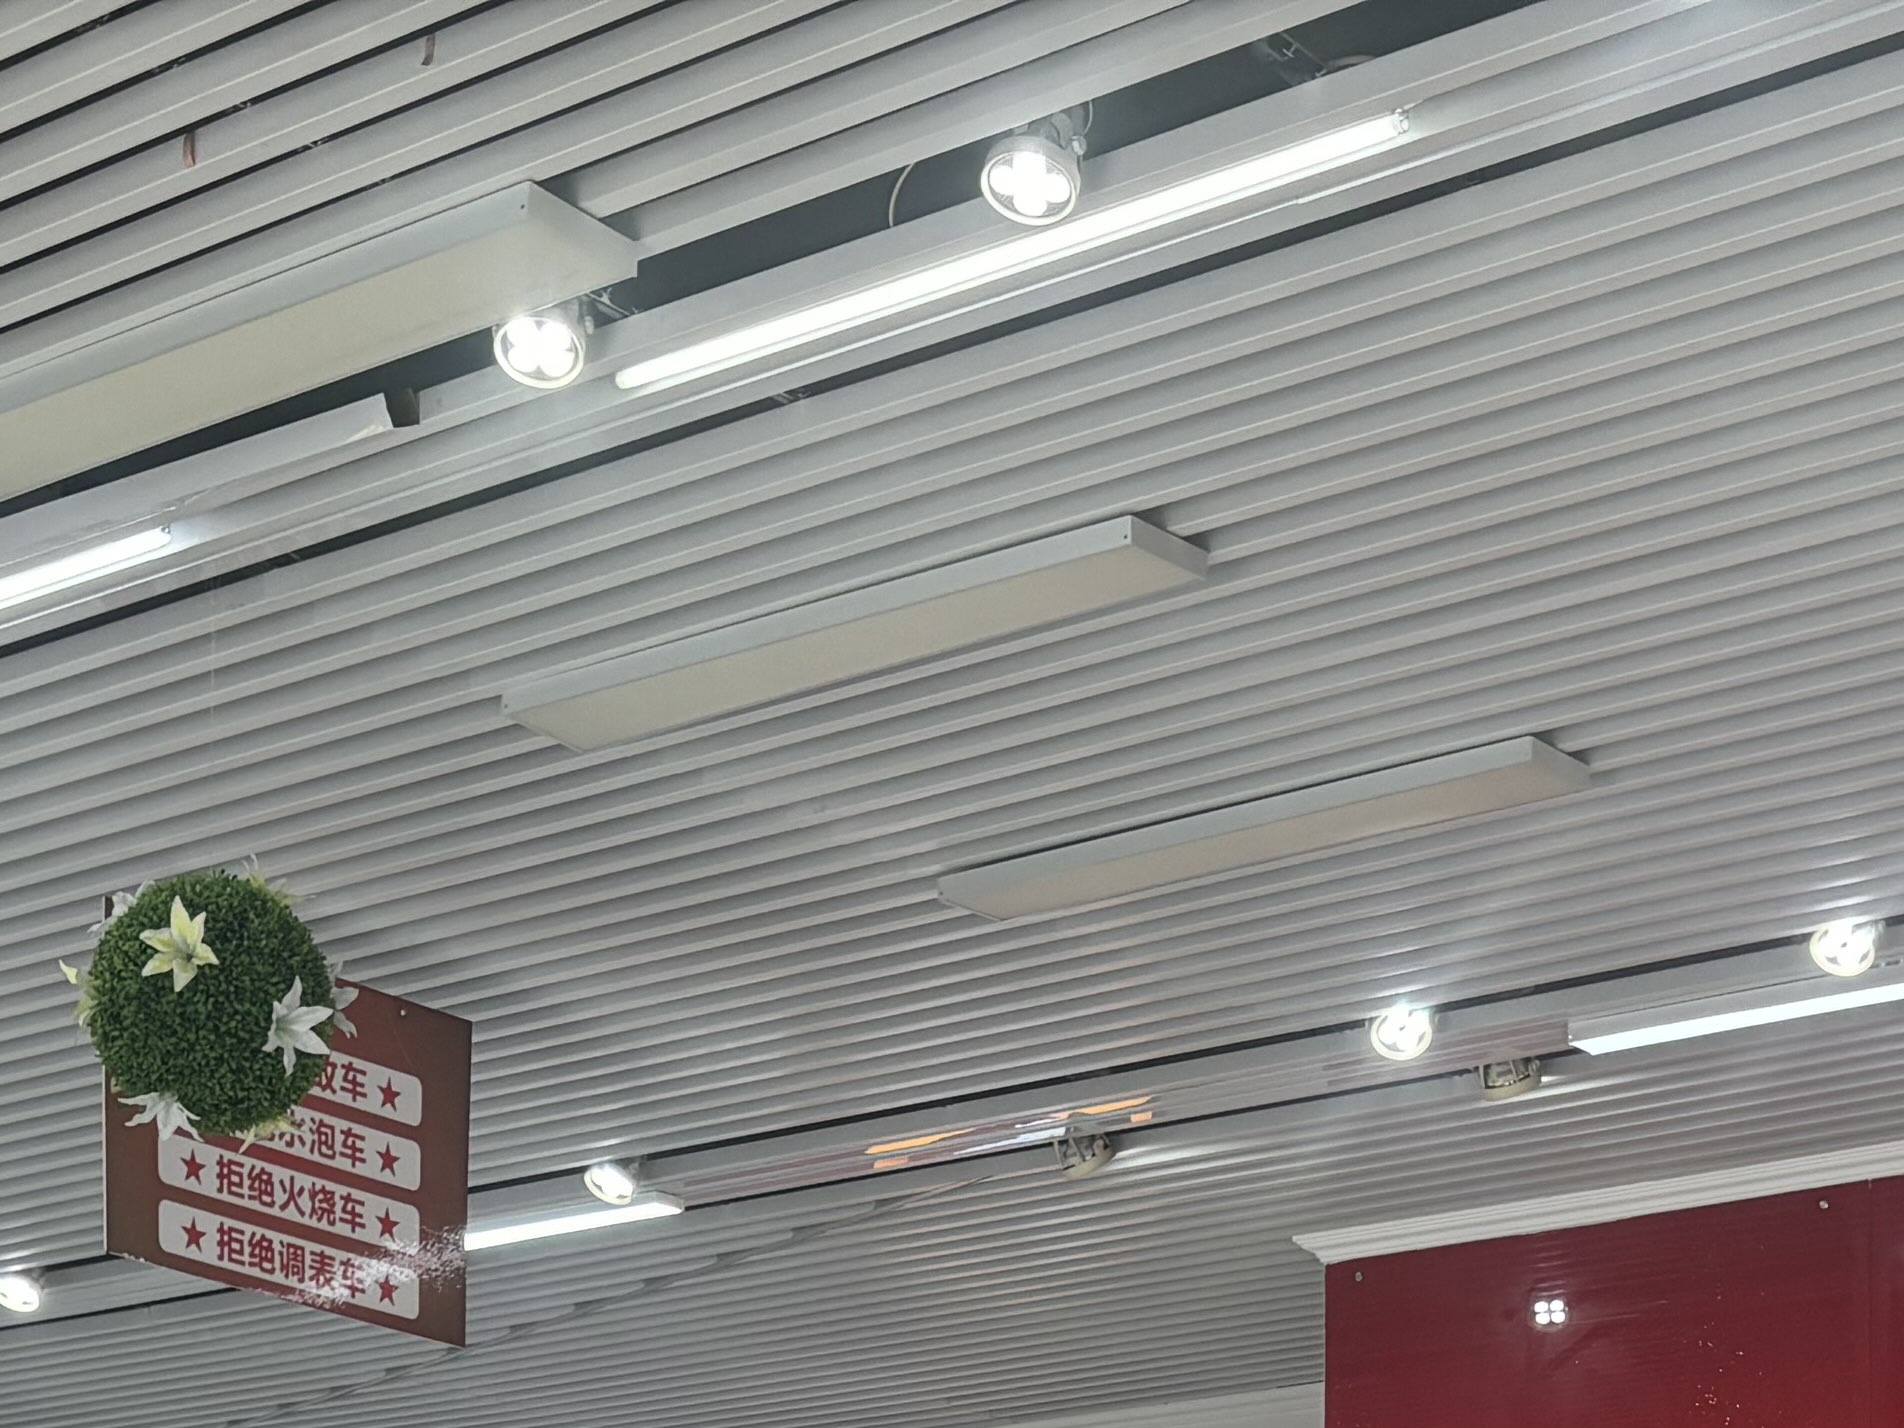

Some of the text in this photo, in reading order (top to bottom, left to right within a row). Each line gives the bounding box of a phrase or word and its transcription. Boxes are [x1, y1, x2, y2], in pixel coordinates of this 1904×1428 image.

[216, 1154, 367, 1235] 拒绝火烧车
[216, 1221, 367, 1300] 拒绝调表车
